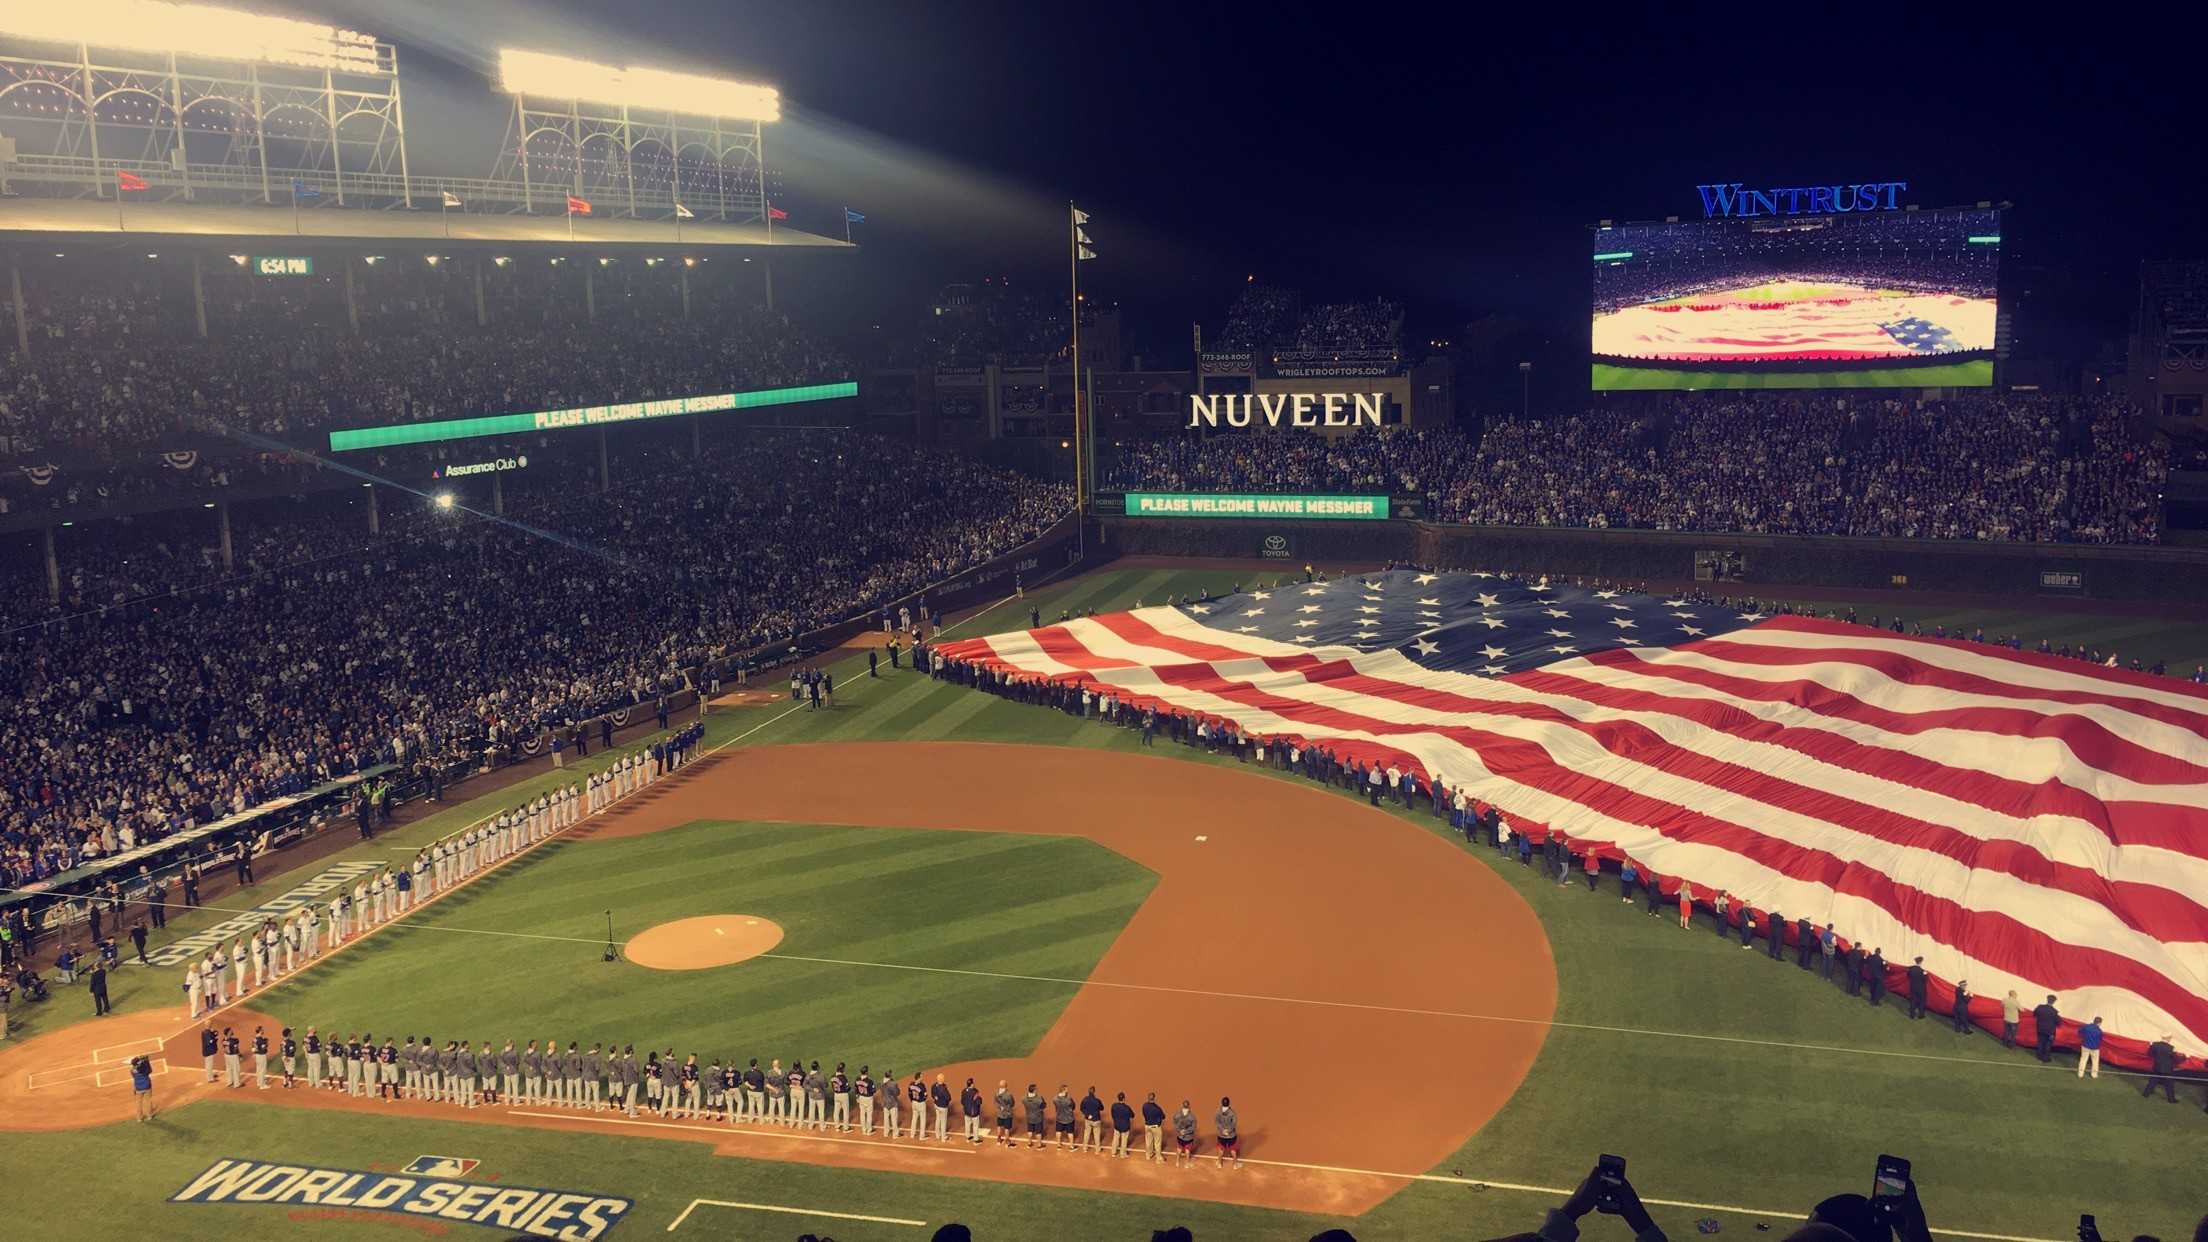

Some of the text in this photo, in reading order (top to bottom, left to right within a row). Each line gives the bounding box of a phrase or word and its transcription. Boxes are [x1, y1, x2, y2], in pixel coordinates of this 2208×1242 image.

[260, 258, 307, 273] 6:54 PM
[1276, 368, 1387, 377] WRIGLEYROOFTOPS.COM
[534, 393, 736, 429] PLEASE WELCOME WAYNE MESSMER
[1190, 392, 1384, 427] NUVEEN
[445, 457, 517, 477] Assurance Club
[1140, 498, 1374, 514] PLEASE WELCOME WAYNE MESSMER
[174, 1160, 629, 1242] WORLD SERIES
